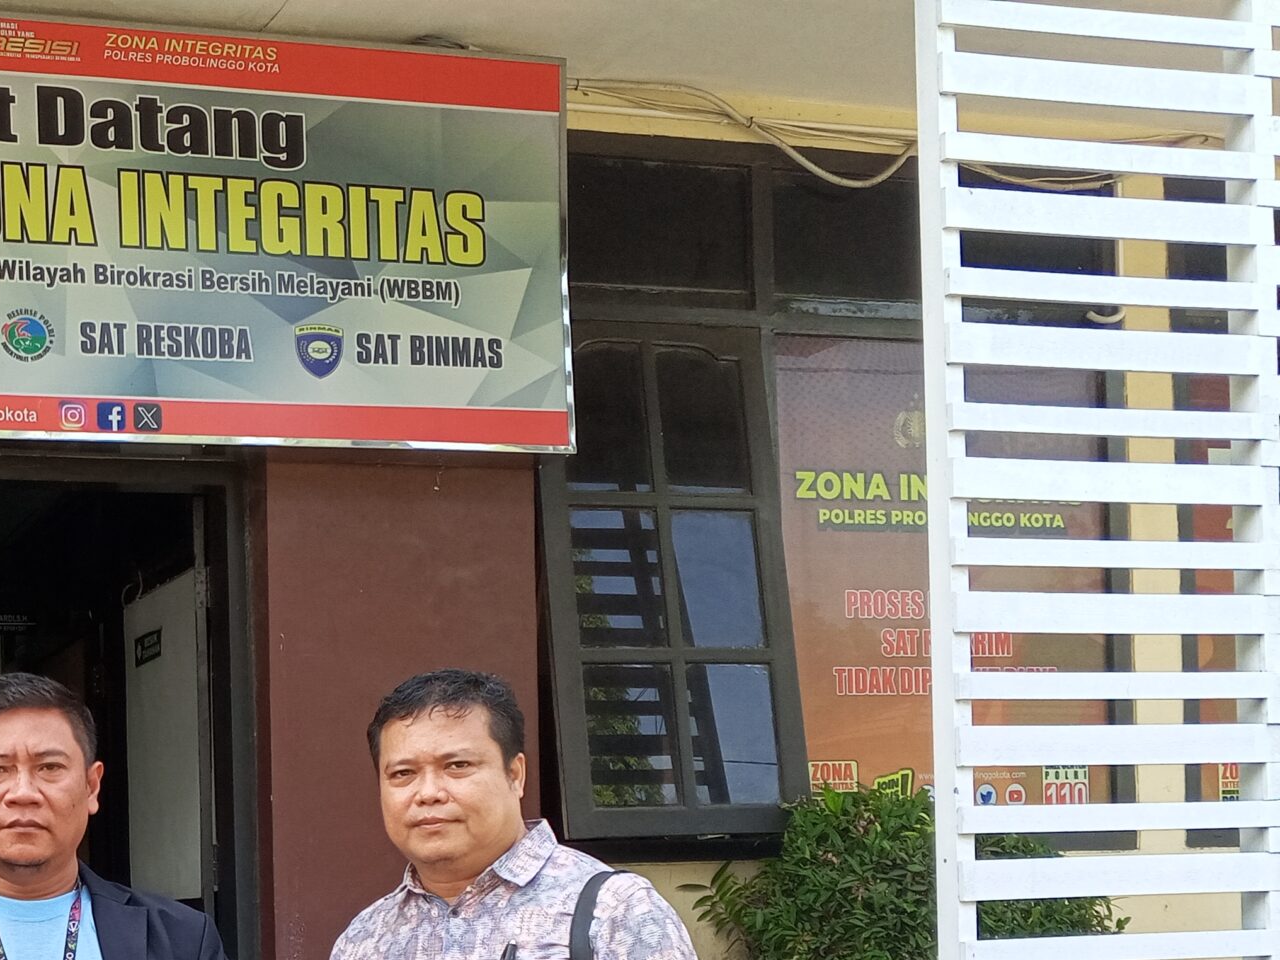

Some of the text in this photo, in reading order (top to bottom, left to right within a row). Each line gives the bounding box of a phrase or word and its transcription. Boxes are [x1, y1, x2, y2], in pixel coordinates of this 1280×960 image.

[105, 33, 277, 60] ZONA INTEGRITAS
[104, 50, 280, 73] POLRES PROBOLINGGO KOTA
[37, 86, 304, 167] Datang
[117, 168, 486, 267] INTEGRITAS
[94, 263, 193, 290] Birokrasi
[201, 268, 270, 293] Bersih
[278, 273, 372, 301] Melayani
[379, 276, 460, 306] (WBBM)
[80, 320, 253, 361] SAT RESKOBA
[356, 332, 504, 369] SAT BINMAS
[795, 472, 891, 501] ZONA
[819, 508, 886, 525] POLRES
[1020, 512, 1065, 529] KOTA
[845, 590, 924, 619] PROSES
[881, 628, 918, 657] SAT
[833, 667, 896, 696] TIDAK
[811, 763, 855, 781] ZONA
